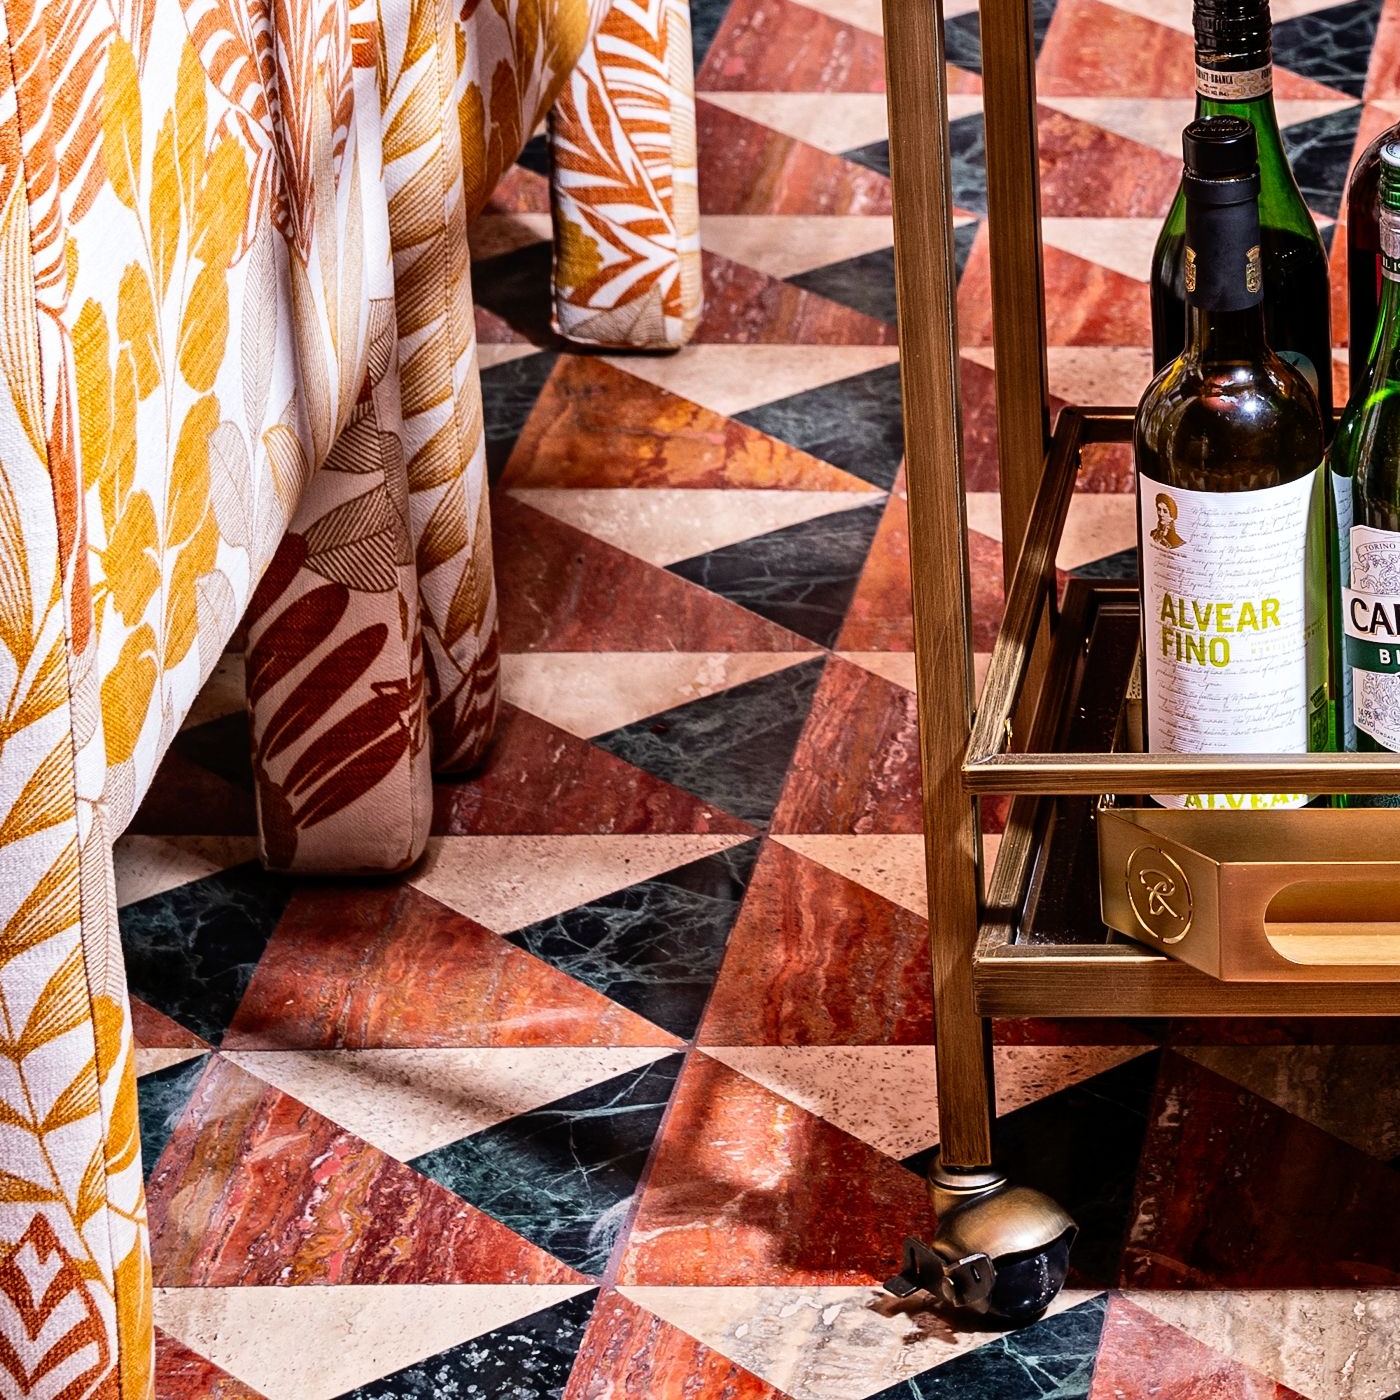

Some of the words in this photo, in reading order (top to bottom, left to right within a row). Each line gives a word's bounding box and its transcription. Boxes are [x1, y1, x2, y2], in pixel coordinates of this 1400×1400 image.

[1364, 543, 1396, 552] TORINO
[1160, 590, 1281, 633] ALVEAR
[1161, 624, 1231, 668] FINO
